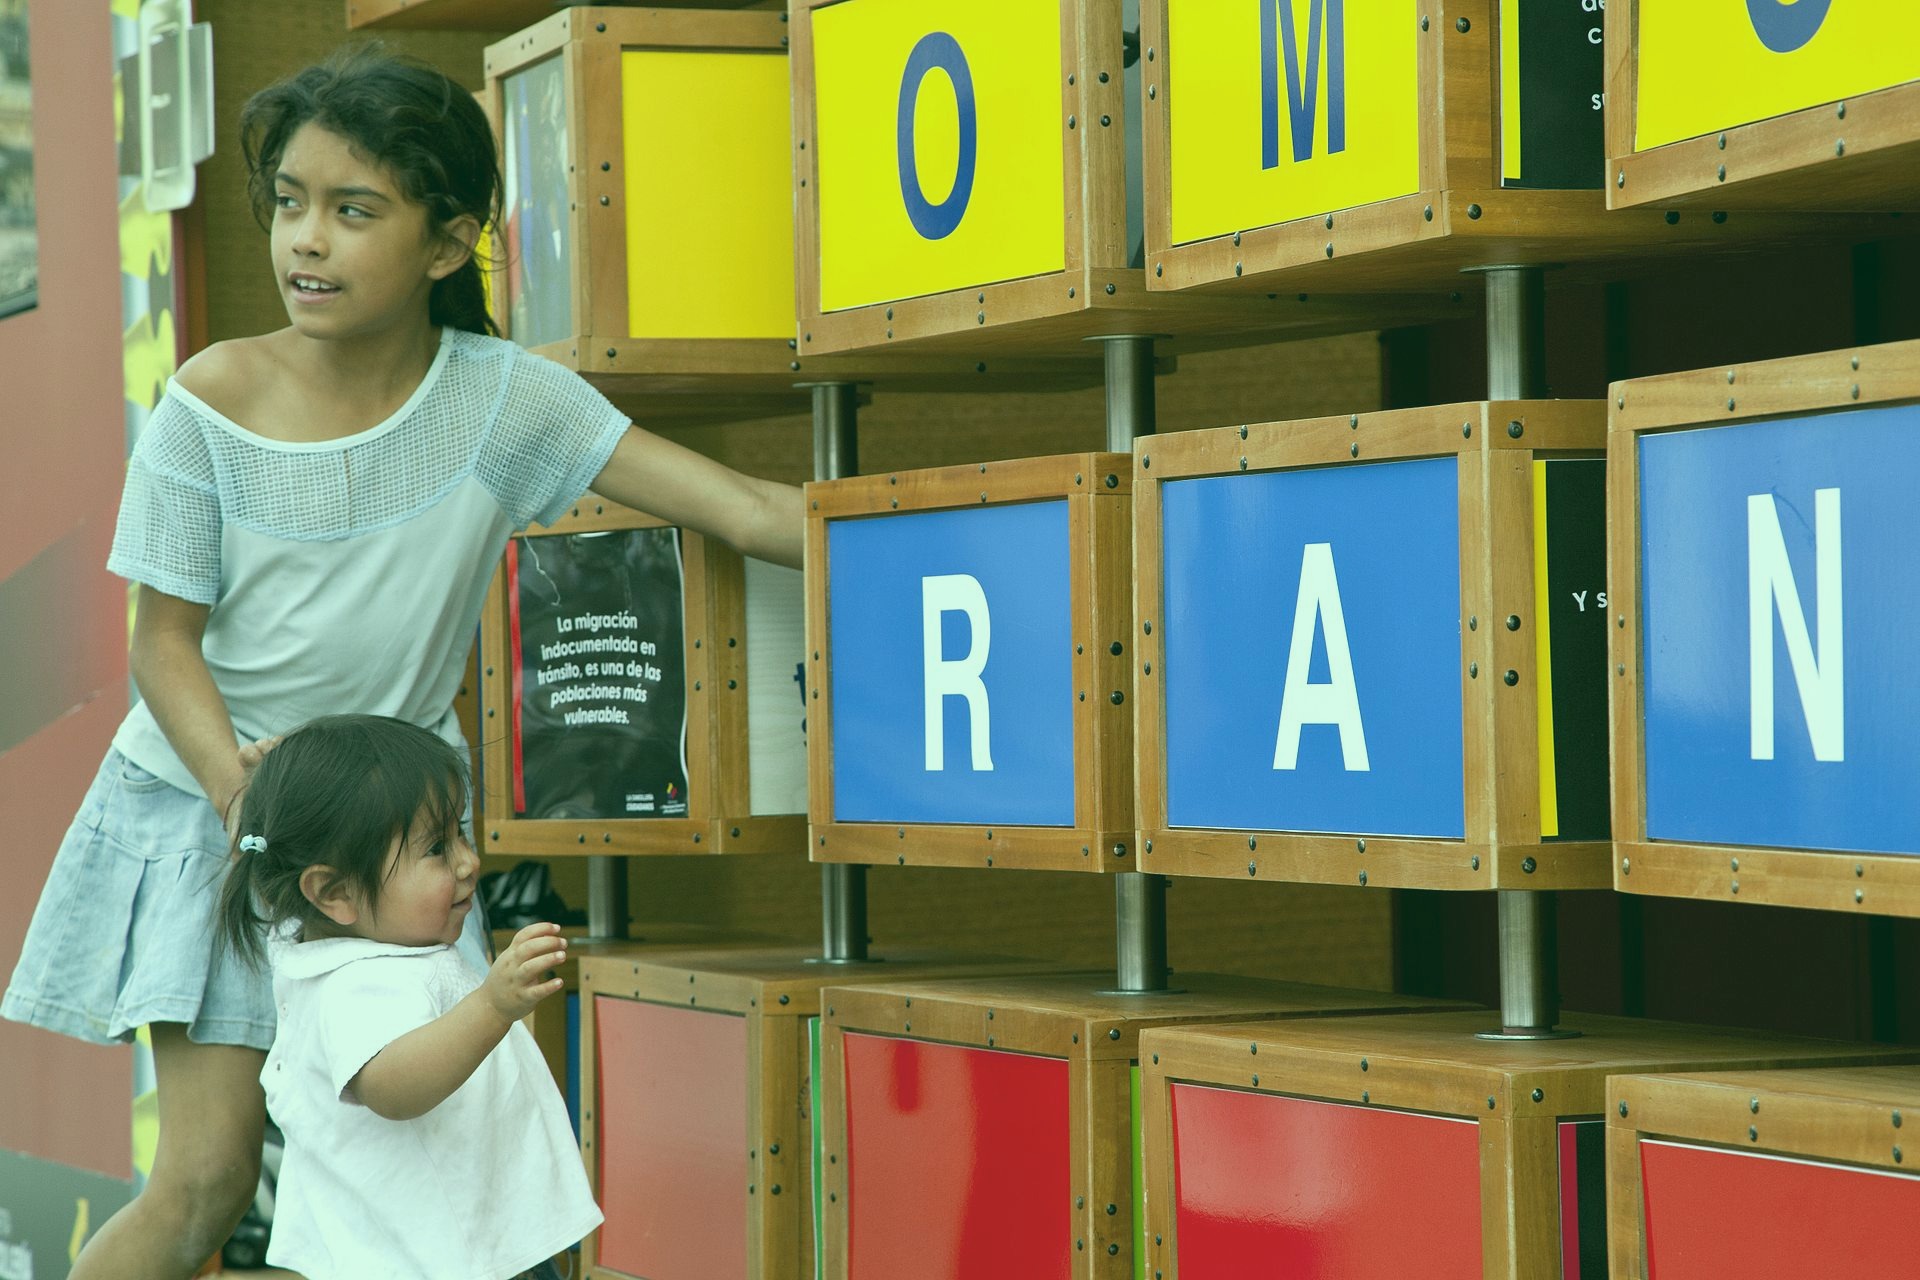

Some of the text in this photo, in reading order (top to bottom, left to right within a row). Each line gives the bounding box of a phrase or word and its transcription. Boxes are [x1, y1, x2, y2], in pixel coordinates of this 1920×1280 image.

[1260, 0, 1345, 169] M
[898, 32, 978, 240] O
[541, 635, 656, 660] indocumentada en
[557, 610, 637, 633] La migración
[1272, 542, 1370, 772] A
[1747, 487, 1844, 762] N
[537, 660, 662, 685] tránsito, es una de las
[550, 682, 648, 709] poblaciones más
[564, 705, 630, 725] vulnerables.
[921, 574, 994, 772] R
